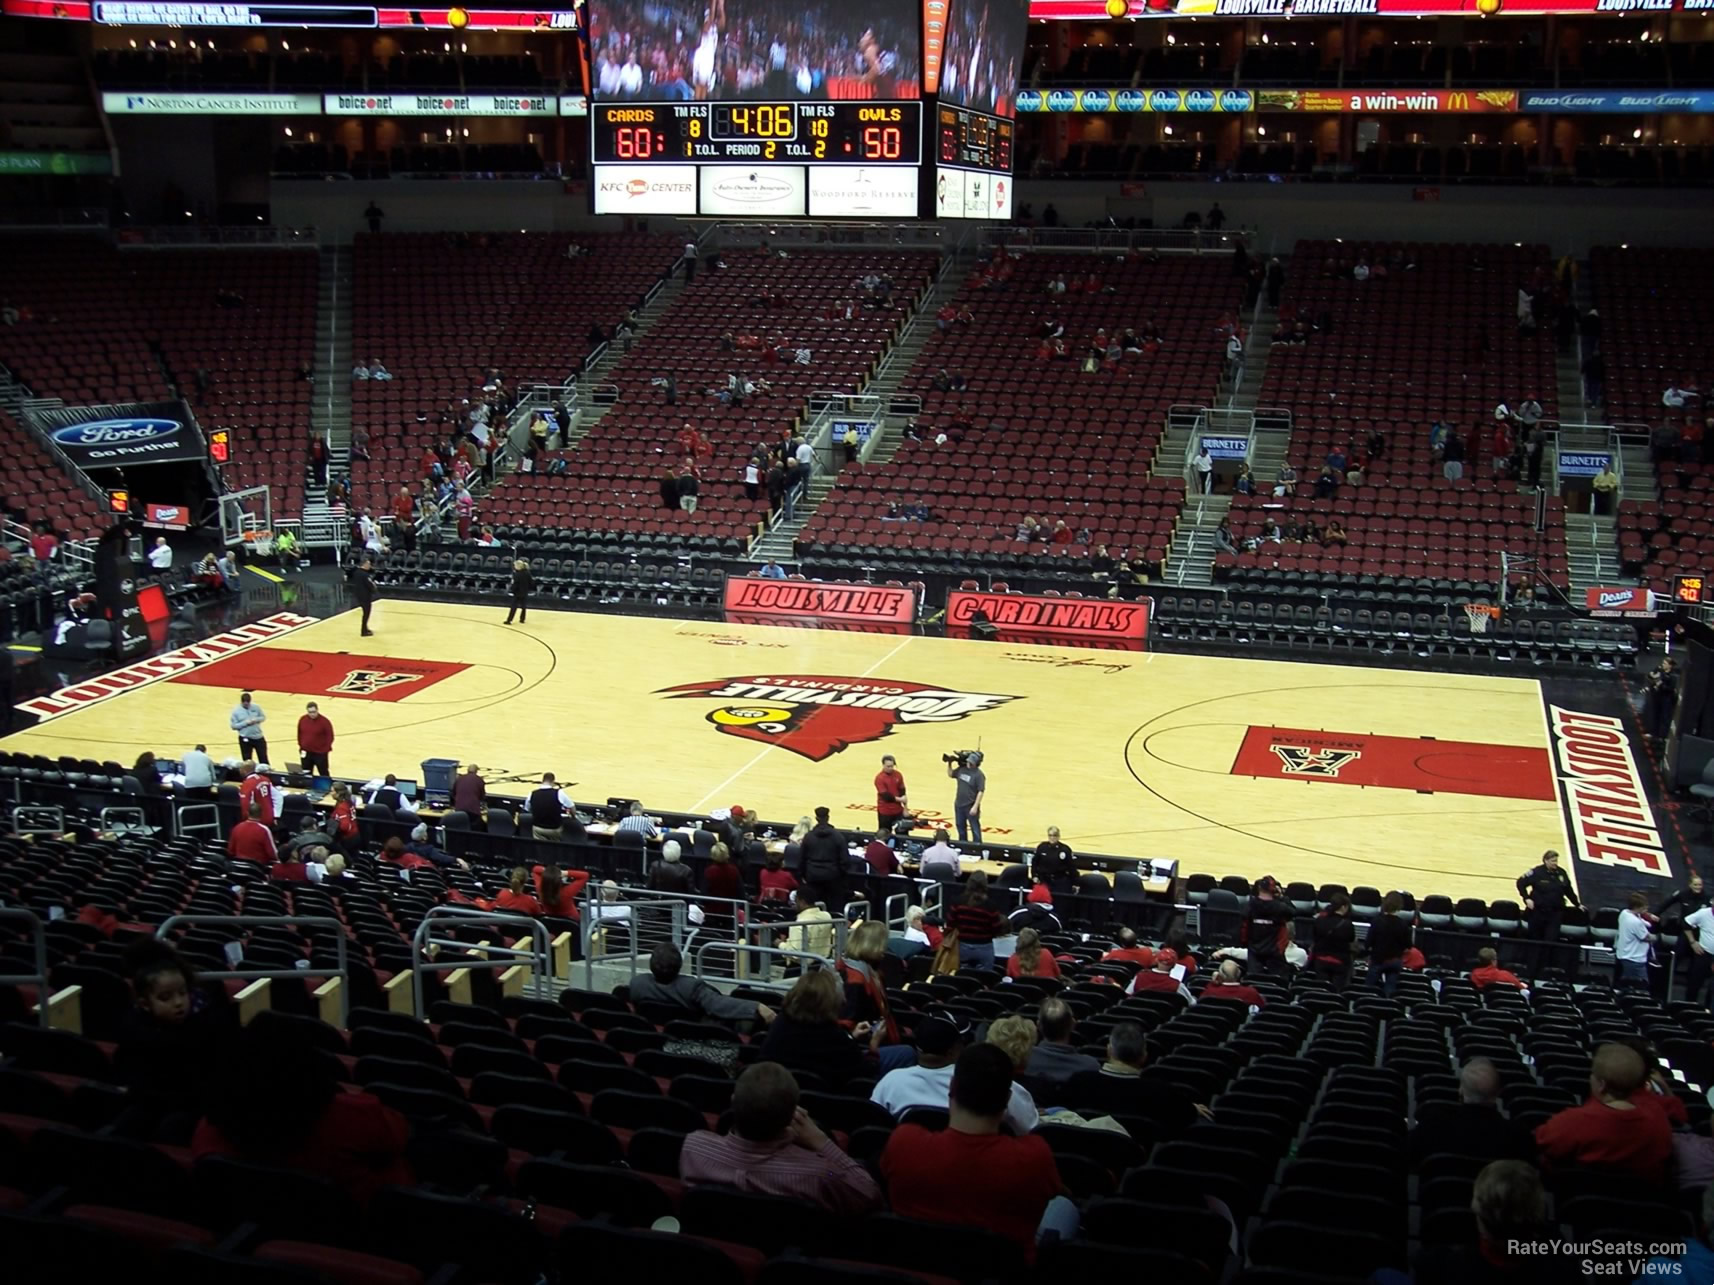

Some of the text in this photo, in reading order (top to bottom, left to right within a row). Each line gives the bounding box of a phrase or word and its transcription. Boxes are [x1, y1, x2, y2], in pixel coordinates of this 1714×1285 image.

[1216, 0, 1377, 14] LOUISVILLE BASKETBALL
[147, 98, 299, 110] NORTON CANCER INSTITUTE
[1351, 92, 1438, 110] a win-win
[1527, 97, 1606, 105] BUD LIGHT
[1619, 97, 1699, 105] BUD LIGHT
[607, 109, 655, 122] CARDS
[674, 106, 707, 117] TM FLS
[800, 106, 835, 117] TM FLS
[859, 108, 902, 121] OWLS
[689, 119, 701, 137] 8
[732, 106, 792, 136] 4:06
[812, 119, 829, 137] 10
[617, 128, 651, 157] 60
[694, 144, 719, 156] T.O.L.
[726, 140, 776, 158] PERIOD 2
[785, 140, 826, 158] T.O.L. 2
[864, 128, 900, 158] 50
[600, 183, 624, 192] KFC
[651, 183, 693, 192] CENTER
[811, 189, 916, 199] WOODFORD RESERVE
[80, 424, 158, 443] Ford
[89, 440, 180, 459] Go Further
[1202, 439, 1246, 450] BURNETT'S
[1561, 455, 1608, 467] BURNETT'S
[734, 583, 904, 617] LOUISVILLE
[1599, 590, 1633, 605] Dean's
[1679, 588, 1698, 602] 90
[953, 596, 1143, 632] CARDINALS
[13, 611, 322, 723] LOUISVILLE
[752, 678, 903, 694] CARDINALS
[711, 682, 1022, 722] LOUISVILLE
[1550, 704, 1673, 878] LOUISVILLE
